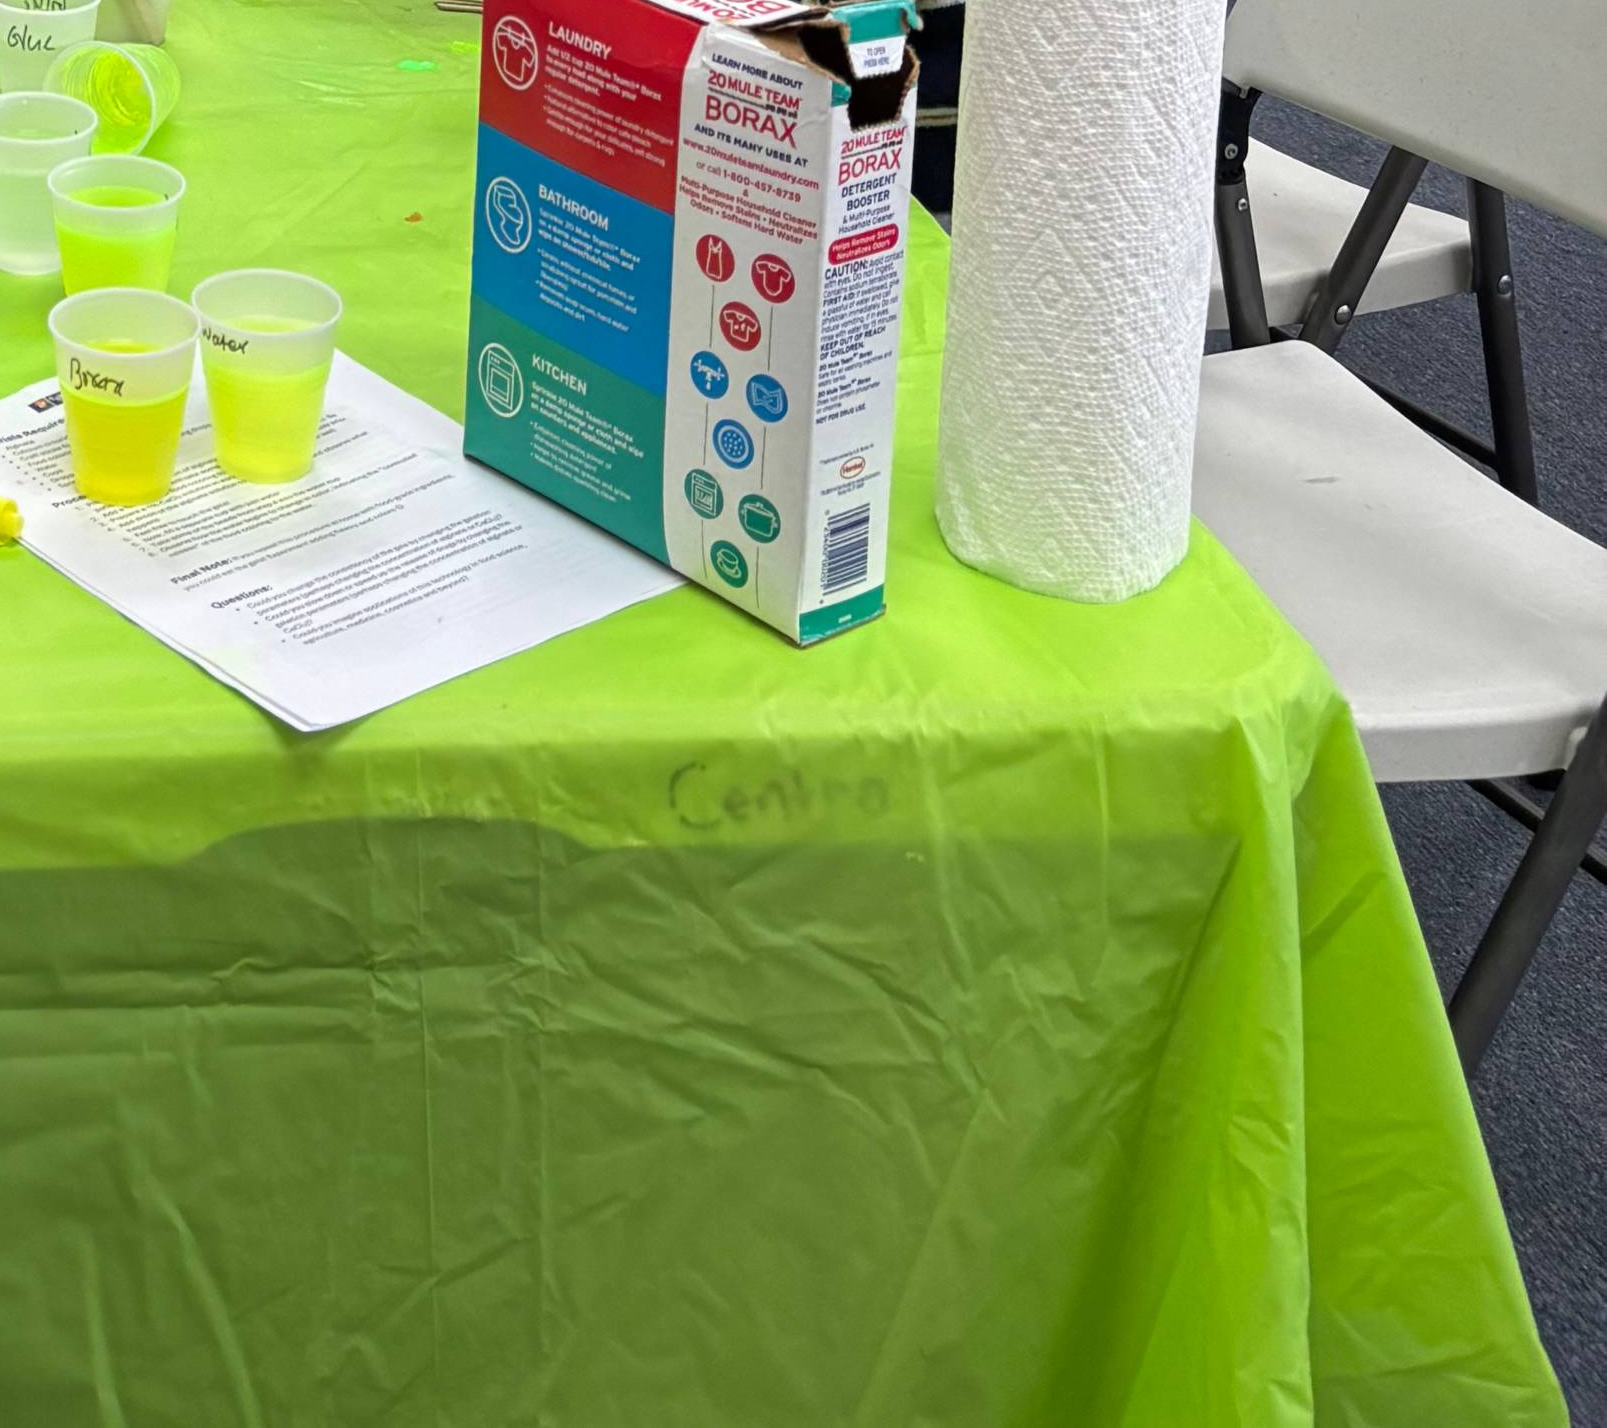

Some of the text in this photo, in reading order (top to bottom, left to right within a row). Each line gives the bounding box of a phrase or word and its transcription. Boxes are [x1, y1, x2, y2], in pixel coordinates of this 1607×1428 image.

[548, 21, 612, 60] LAUNDRY
[712, 53, 803, 90] LEARN MORE ABOUT
[707, 70, 800, 111] 20 MULE TEAM
[705, 94, 798, 150] BORAX
[694, 123, 809, 169] AND ITS MANY USES AT
[841, 125, 907, 154] 20 MULE TEAM
[837, 147, 902, 186] BORAX
[681, 175, 735, 202] Multi-Purpose
[736, 196, 782, 218] Household
[841, 173, 897, 198] DETERGENT
[538, 184, 609, 232] BATHROOM
[846, 190, 890, 212] BOOSTER
[848, 204, 890, 223] Multi-Purpose
[701, 194, 734, 212] Remove
[735, 205, 761, 222] Stains
[768, 217, 818, 240] Neutralizes
[721, 210, 753, 229] Softens
[754, 222, 775, 237] Hard
[776, 230, 803, 245] Water
[838, 212, 894, 235] Household Cleaner
[835, 238, 891, 260] Neutralizes Odors
[852, 232, 877, 247] Remove
[877, 227, 897, 240] Stains
[824, 259, 868, 281] CAUTION:
[202, 327, 249, 355] Water
[820, 339, 839, 352] KEEP
[864, 326, 886, 341] REACH
[532, 354, 587, 396] KITCHEN
[23, 418, 65, 438] Require
[170, 558, 233, 586] Final Note:
[211, 585, 273, 610] Questions:
[669, 761, 890, 831] Centro
